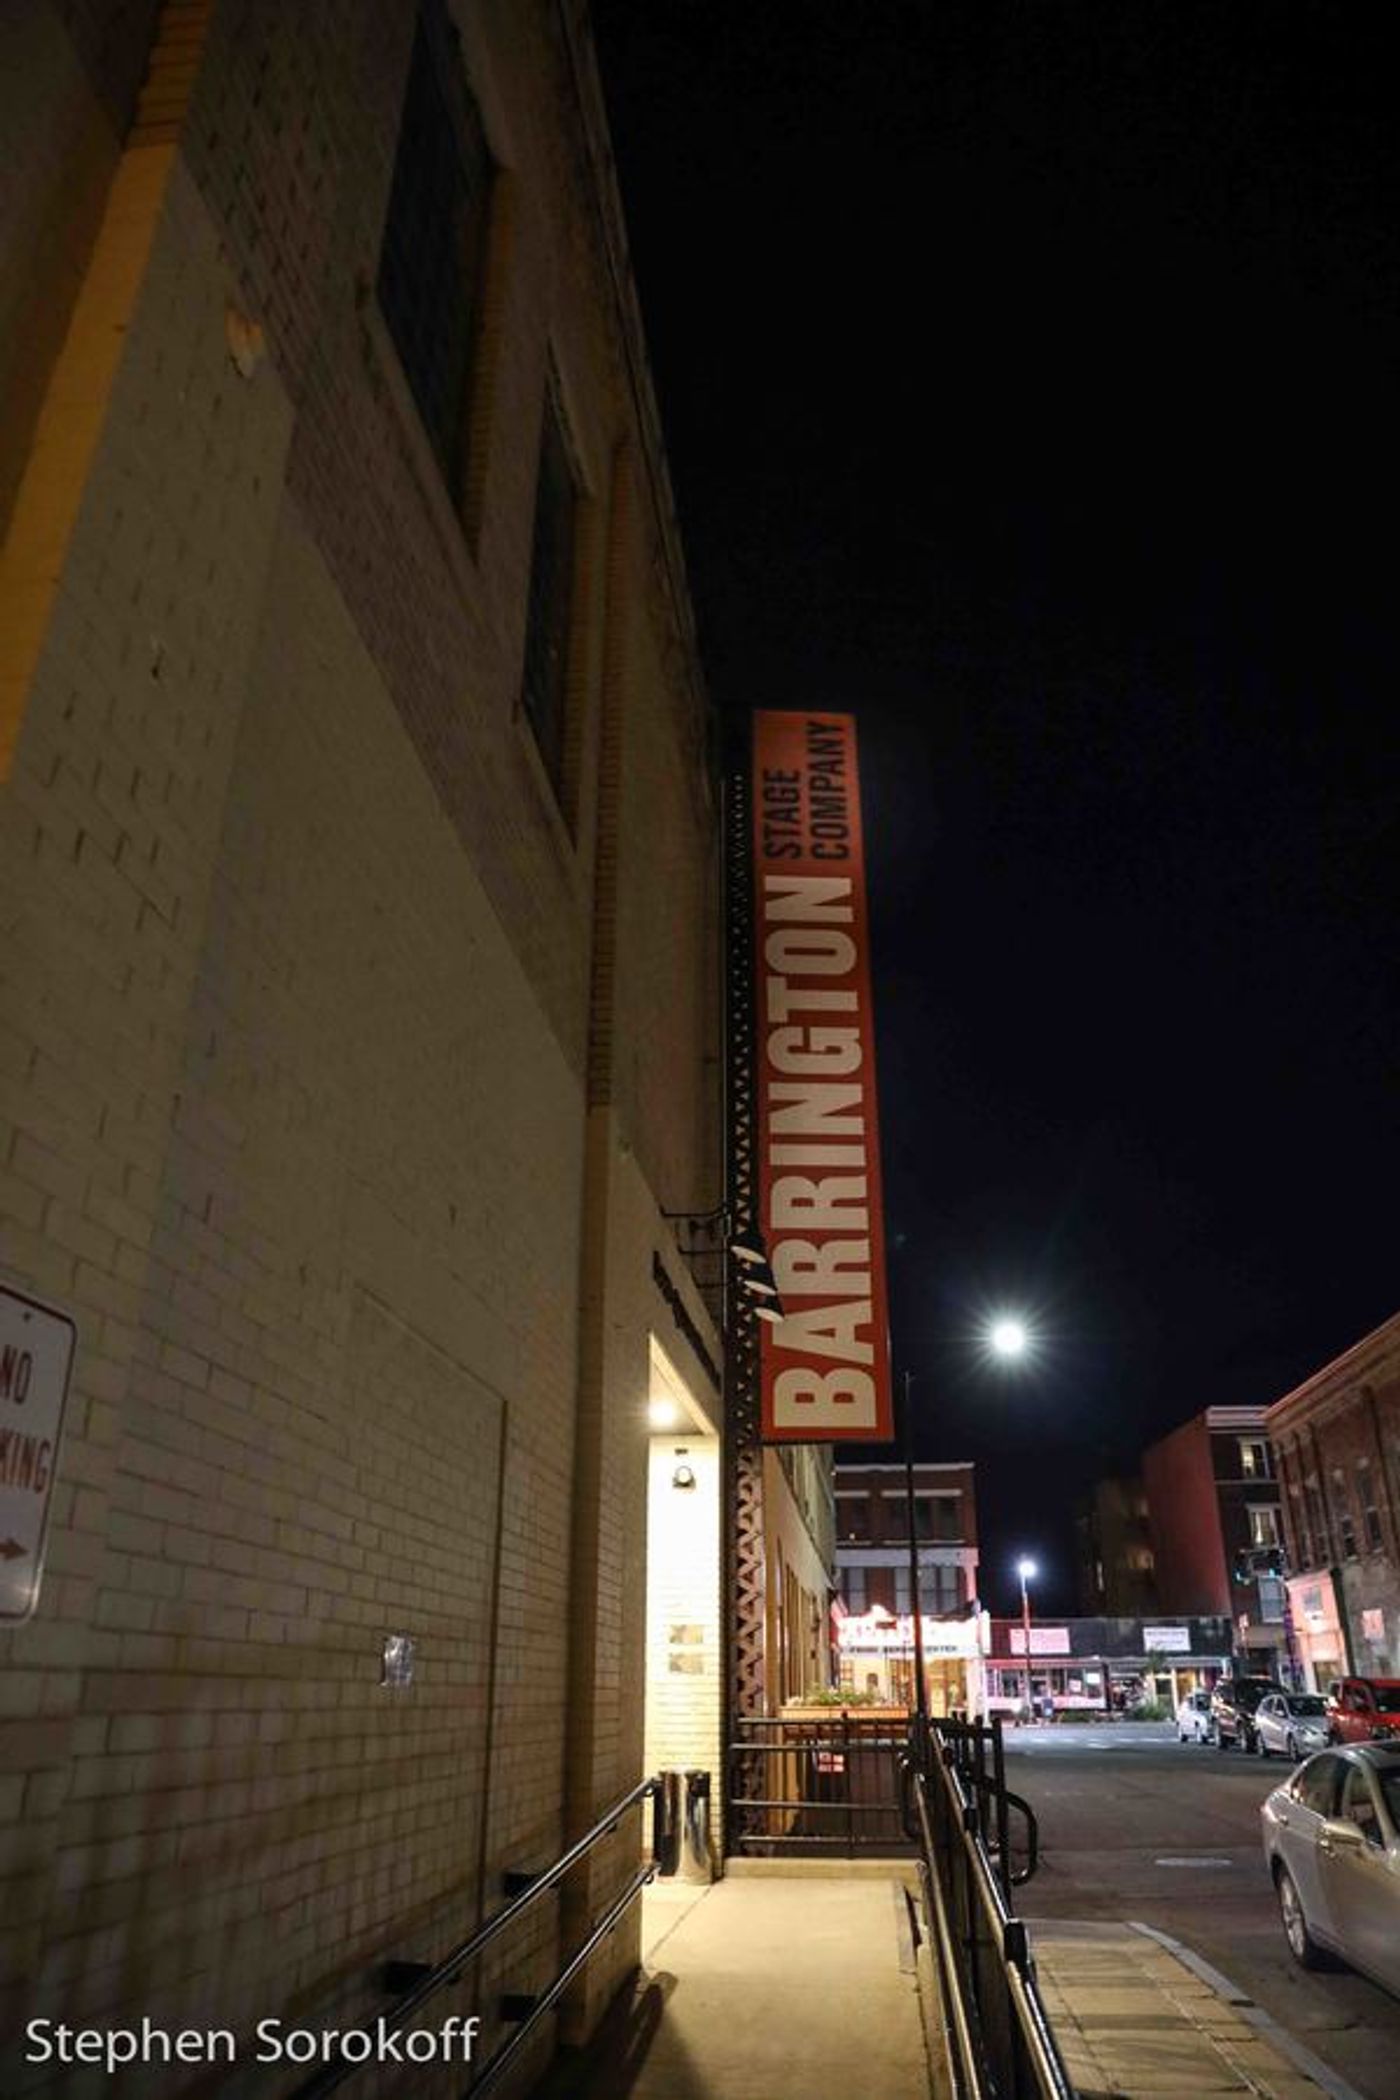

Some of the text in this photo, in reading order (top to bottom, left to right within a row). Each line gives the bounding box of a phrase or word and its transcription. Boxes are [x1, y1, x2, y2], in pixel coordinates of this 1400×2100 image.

[763, 768, 802, 859] STAGE
[807, 720, 849, 860] COMPANY
[764, 875, 877, 1428] BARRINGTON
[0, 1343, 32, 1405] NO
